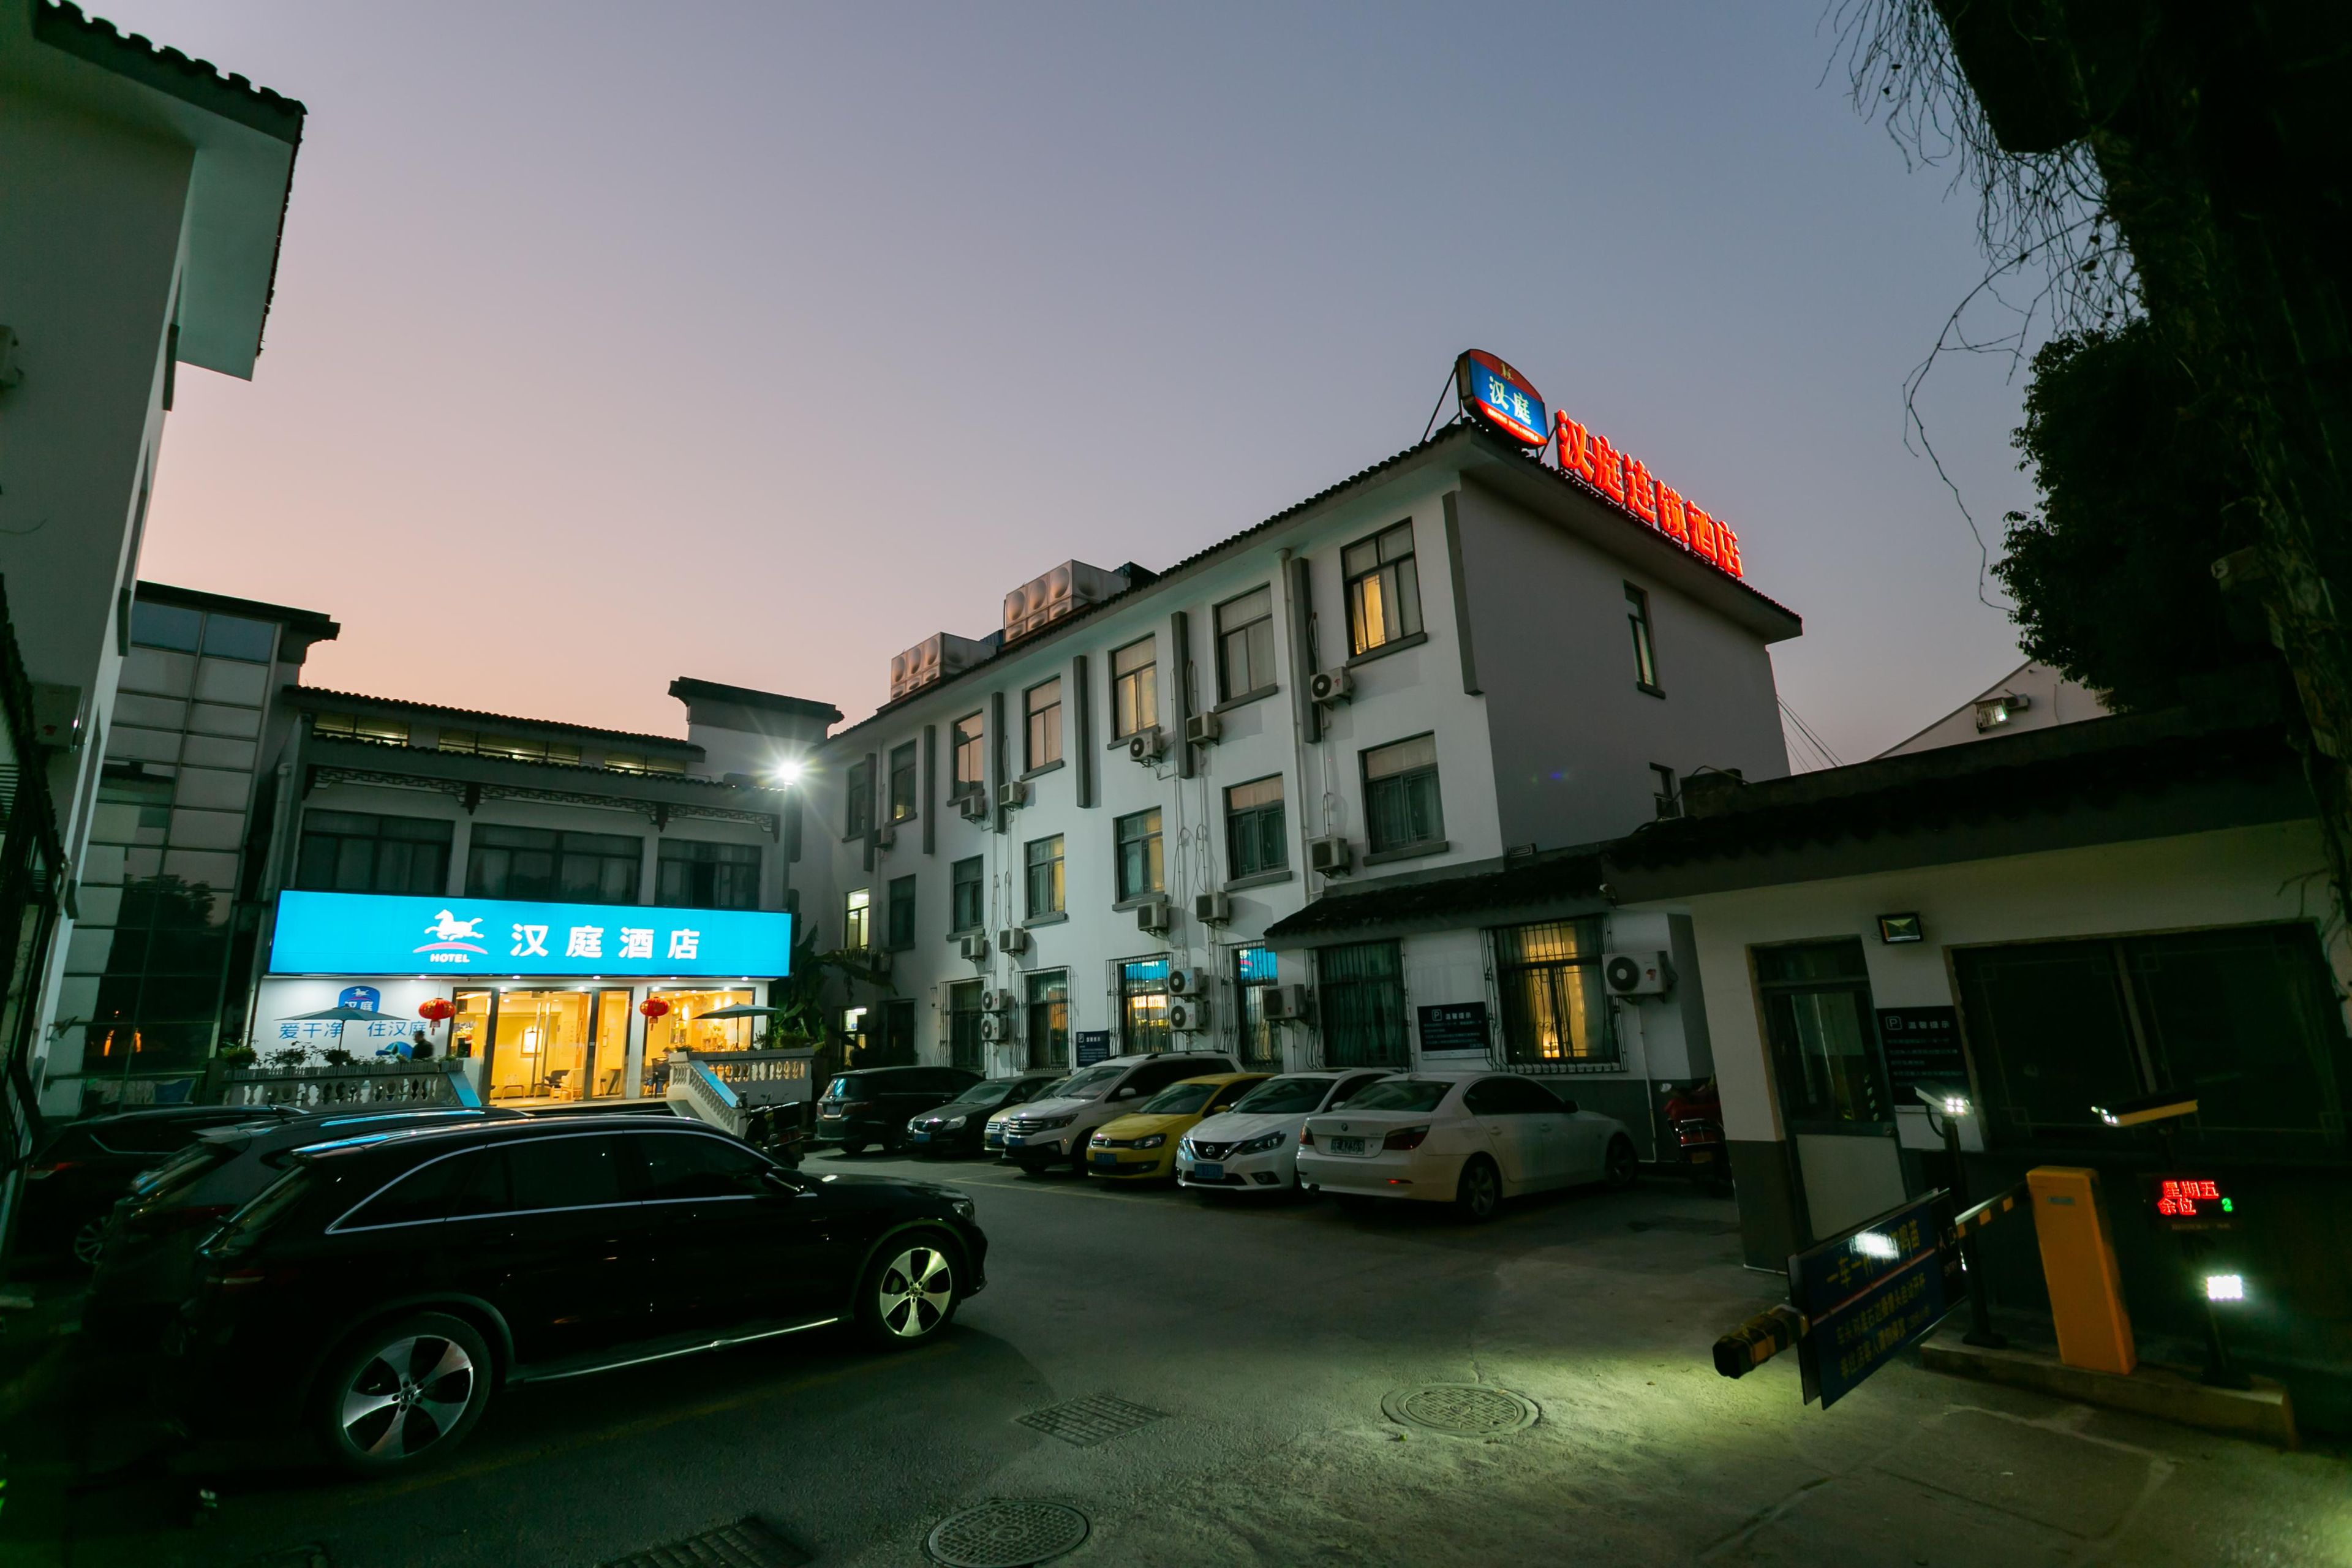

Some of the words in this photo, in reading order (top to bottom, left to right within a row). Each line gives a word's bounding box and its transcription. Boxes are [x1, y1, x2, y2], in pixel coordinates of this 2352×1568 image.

[1489, 375, 1531, 425] 汉庭
[1556, 409, 1744, 577] 汉庭连锁酒店
[510, 923, 700, 960] 汉庭酒店
[430, 953, 470, 963] HOTEL
[279, 1022, 342, 1039] 爱干净
[2163, 1180, 2219, 1199] 星期五
[2158, 1197, 2196, 1215] 余位
[2221, 1197, 2233, 1212] 2
